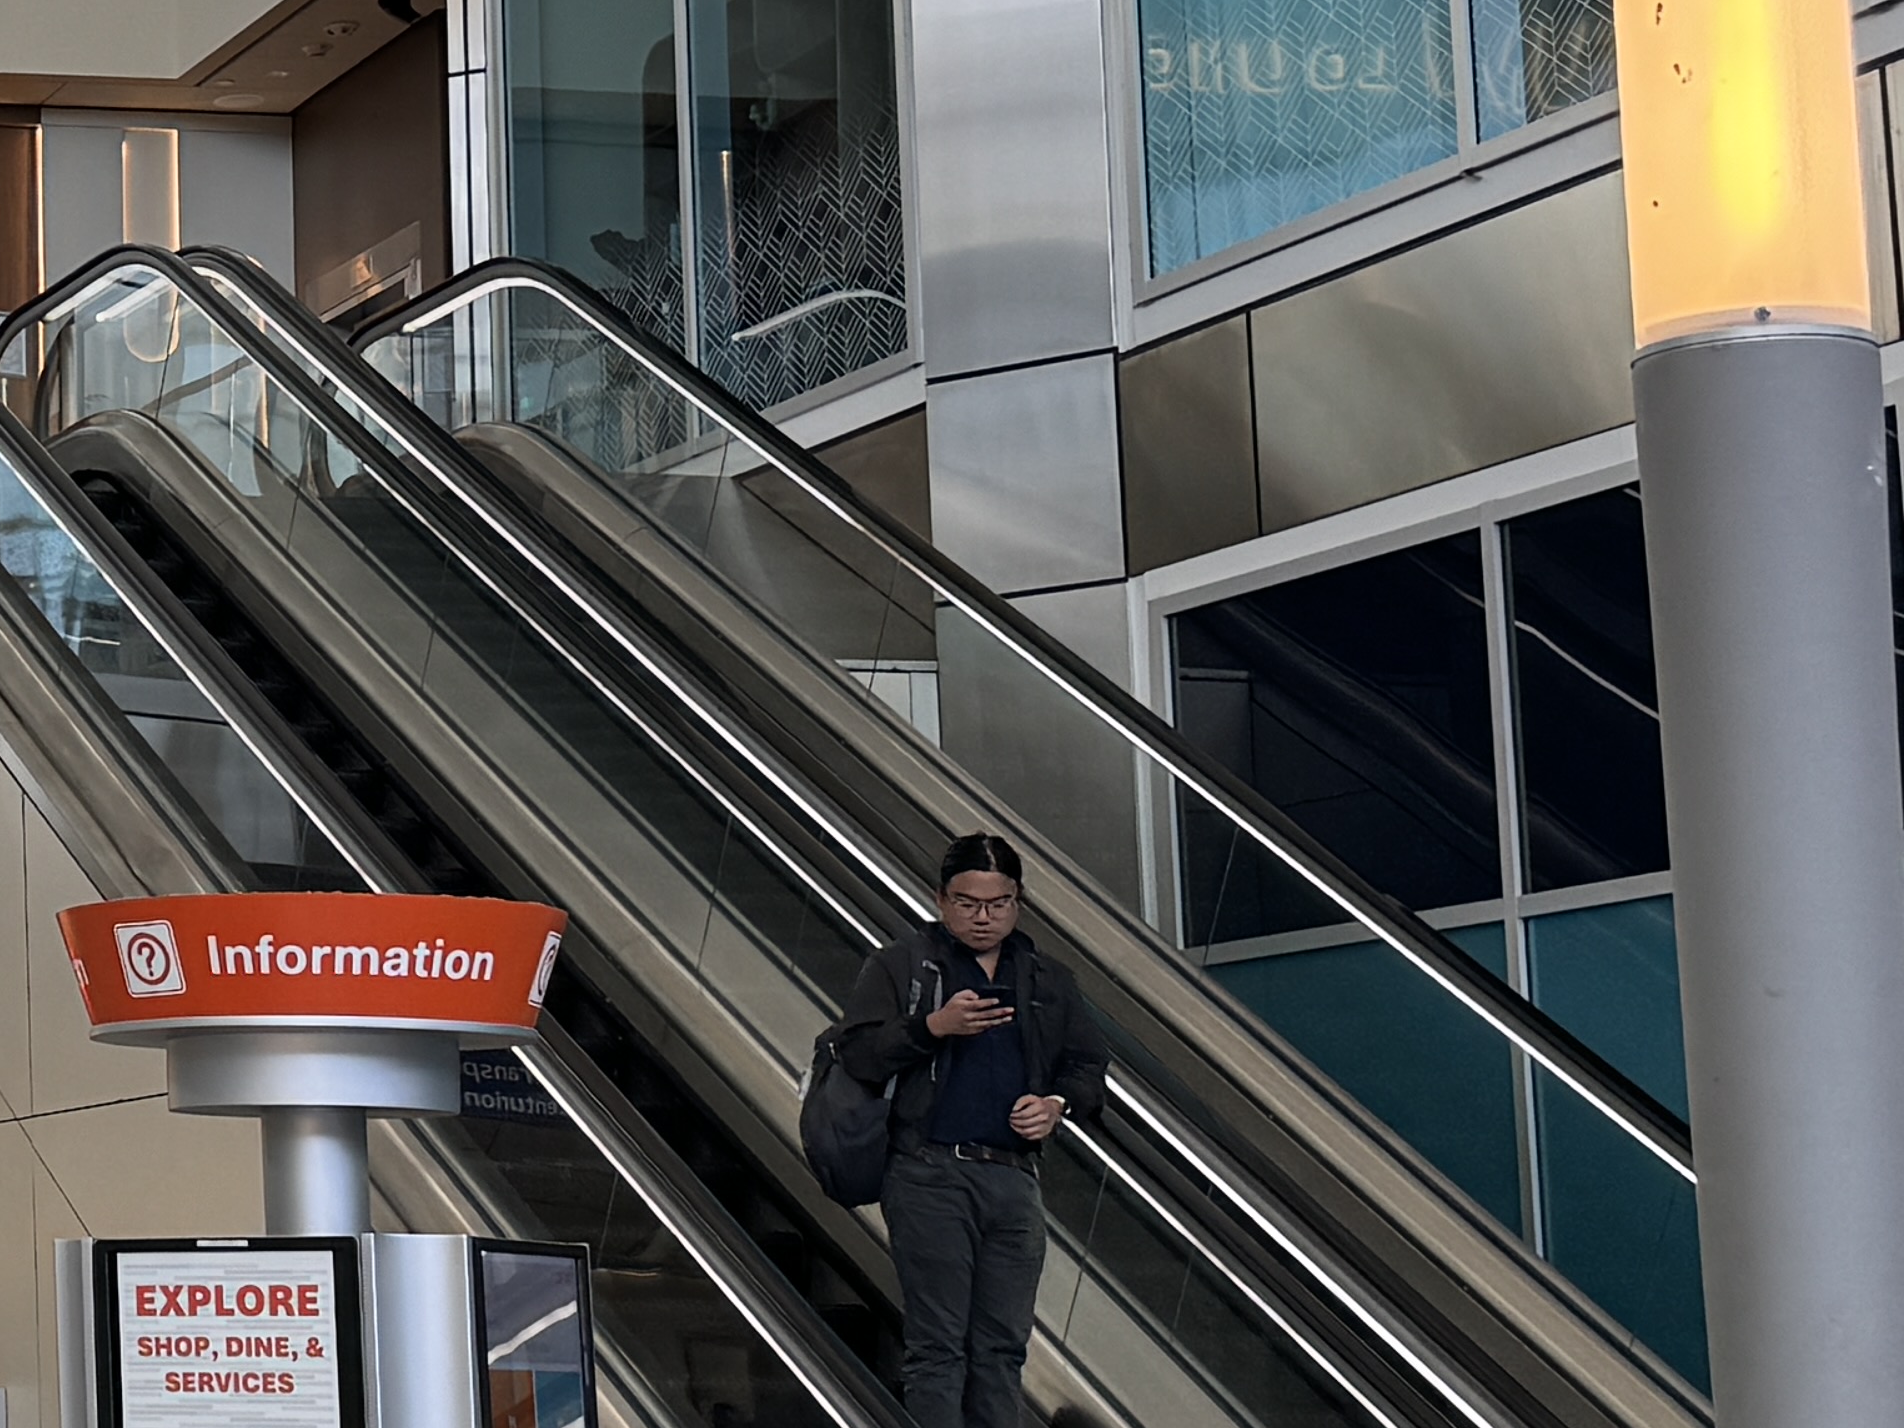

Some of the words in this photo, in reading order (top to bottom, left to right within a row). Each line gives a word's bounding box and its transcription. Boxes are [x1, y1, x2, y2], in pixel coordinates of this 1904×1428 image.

[206, 933, 495, 982] Information
[135, 1283, 321, 1317] EXPLORE
[137, 1336, 219, 1361] SHOP,
[225, 1337, 299, 1362] DINE,
[306, 1338, 325, 1359] &
[164, 1371, 296, 1394] SERVICES
